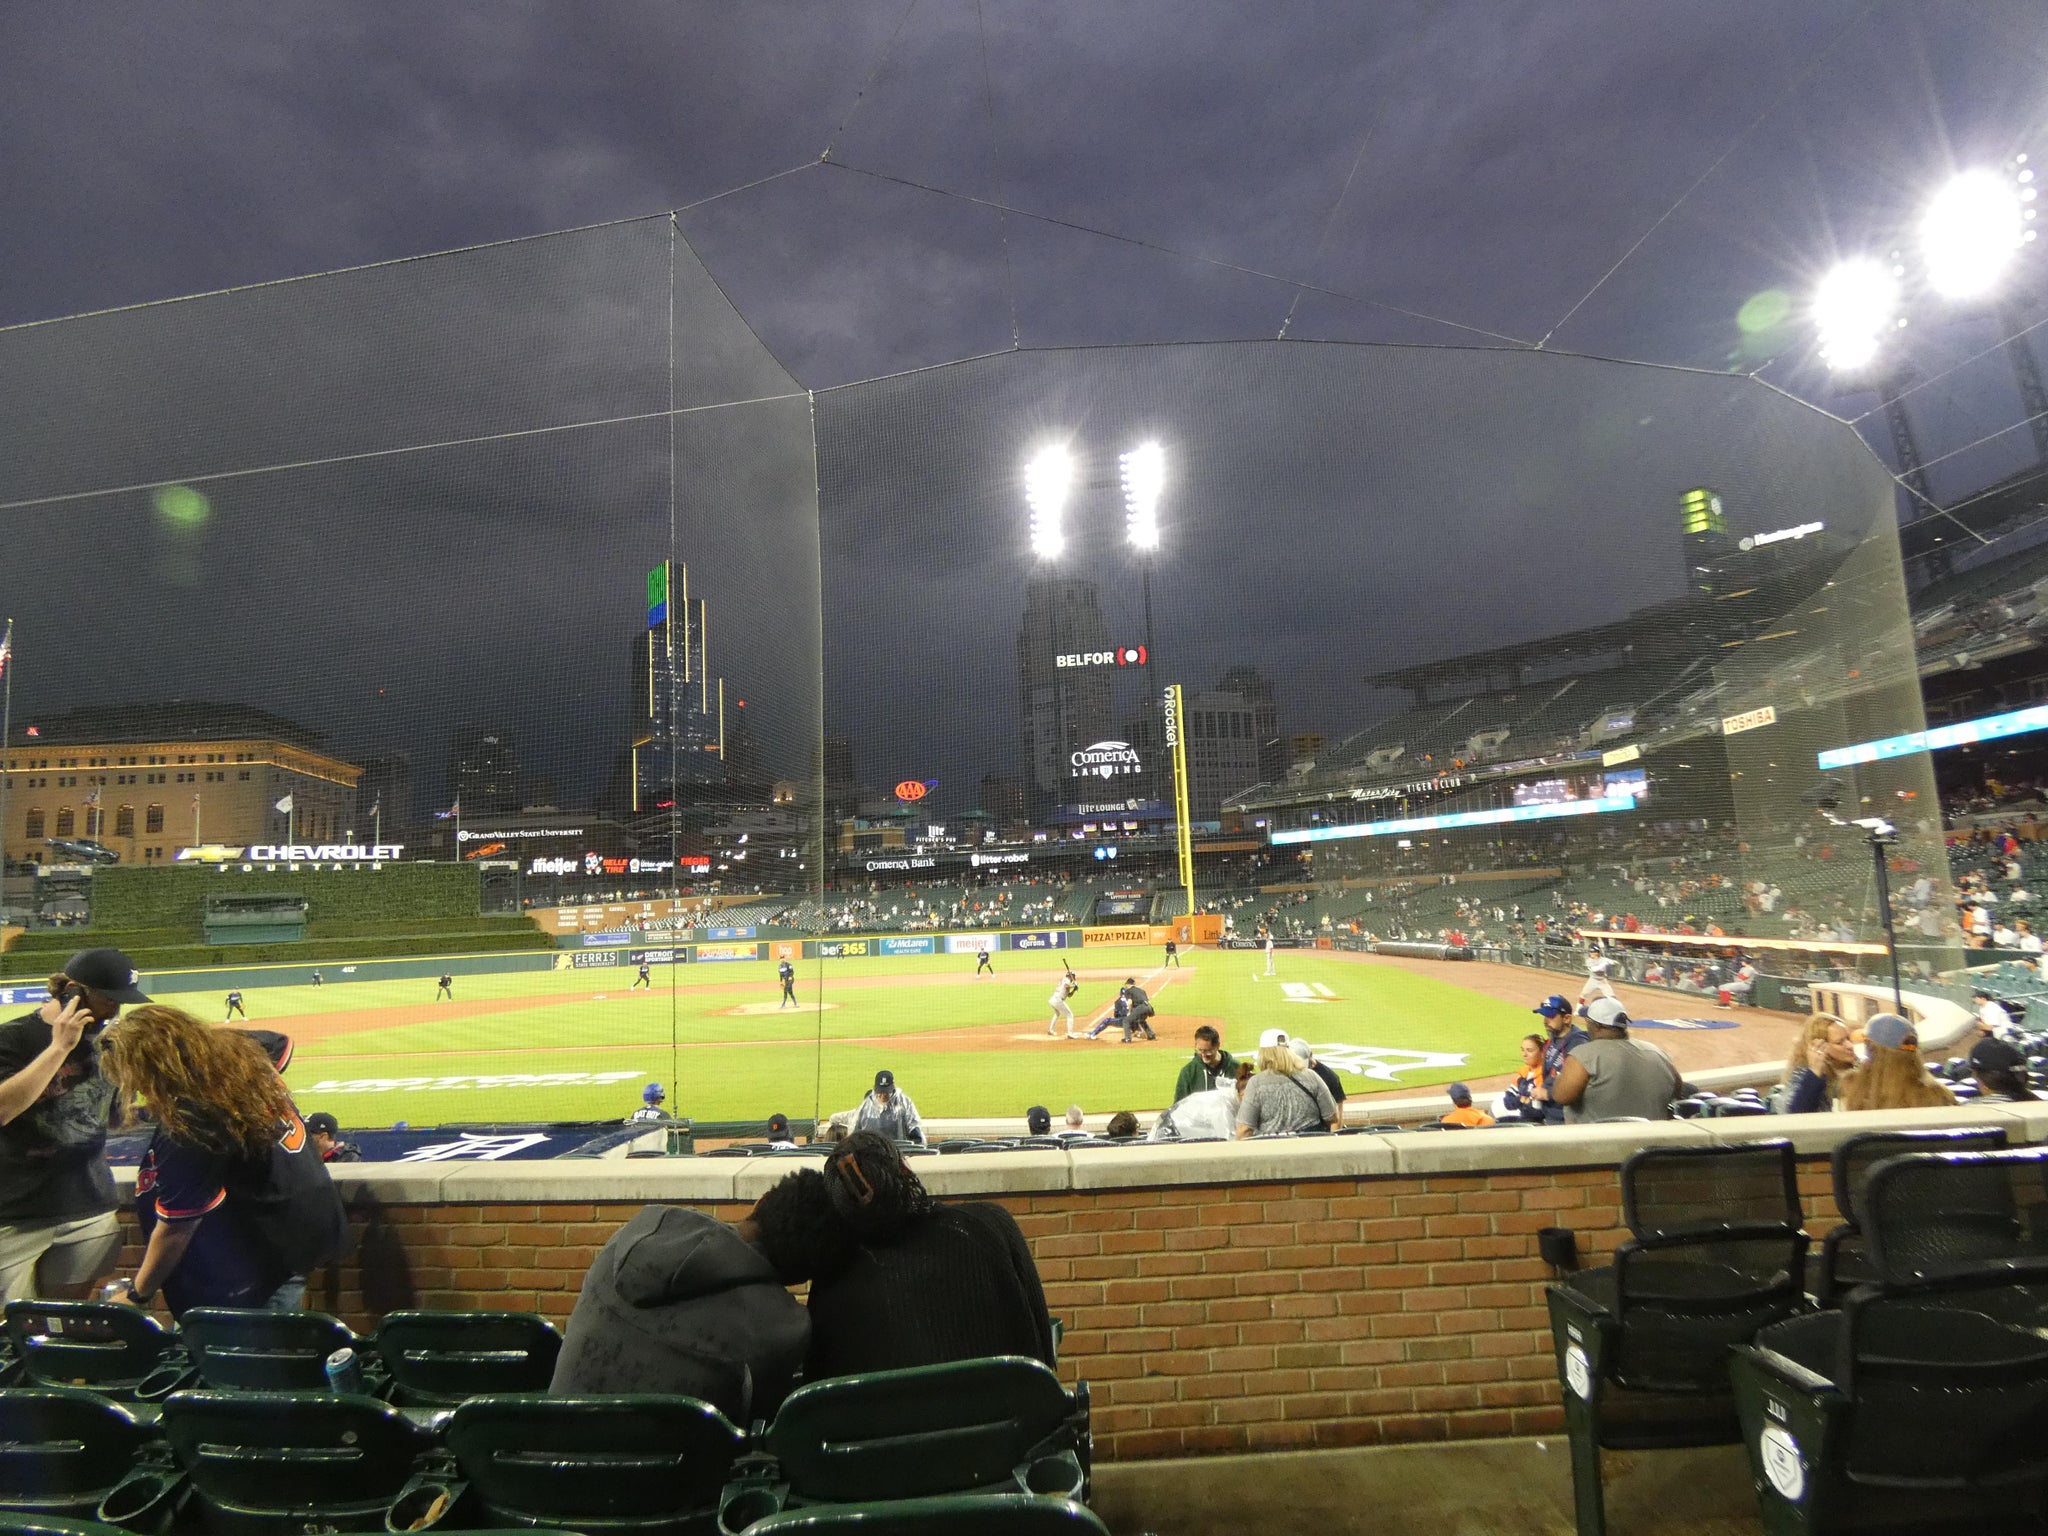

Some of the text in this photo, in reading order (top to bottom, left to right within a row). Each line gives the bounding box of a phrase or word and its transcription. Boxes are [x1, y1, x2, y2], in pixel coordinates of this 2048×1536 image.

[1056, 652, 1115, 667] BELFOR
[1164, 700, 1179, 748] Rocket
[1724, 709, 1772, 730] TOSHIBA
[898, 783, 923, 798] AAA
[1407, 778, 1461, 793] TIGER CLUB
[1078, 803, 1125, 815] Lite LOUNGE
[928, 825, 945, 838] Lite
[250, 845, 405, 860] CHEVROLET
[220, 863, 382, 872] FOUNTAIN
[533, 856, 578, 875] meijer
[911, 858, 936, 868] Bank
[691, 865, 710, 873] LAW
[643, 903, 652, 911] 10
[703, 898, 712, 906] 42
[1084, 932, 1114, 942] PIZZA!
[1115, 931, 1146, 941] PIZZA!
[898, 939, 929, 948] McLaren
[956, 939, 988, 951] meijer
[1019, 939, 1045, 949] Corona
[575, 952, 616, 963] FERRIS
[645, 951, 674, 959] DETROIT
[634, 1110, 660, 1120] BAT BOY
